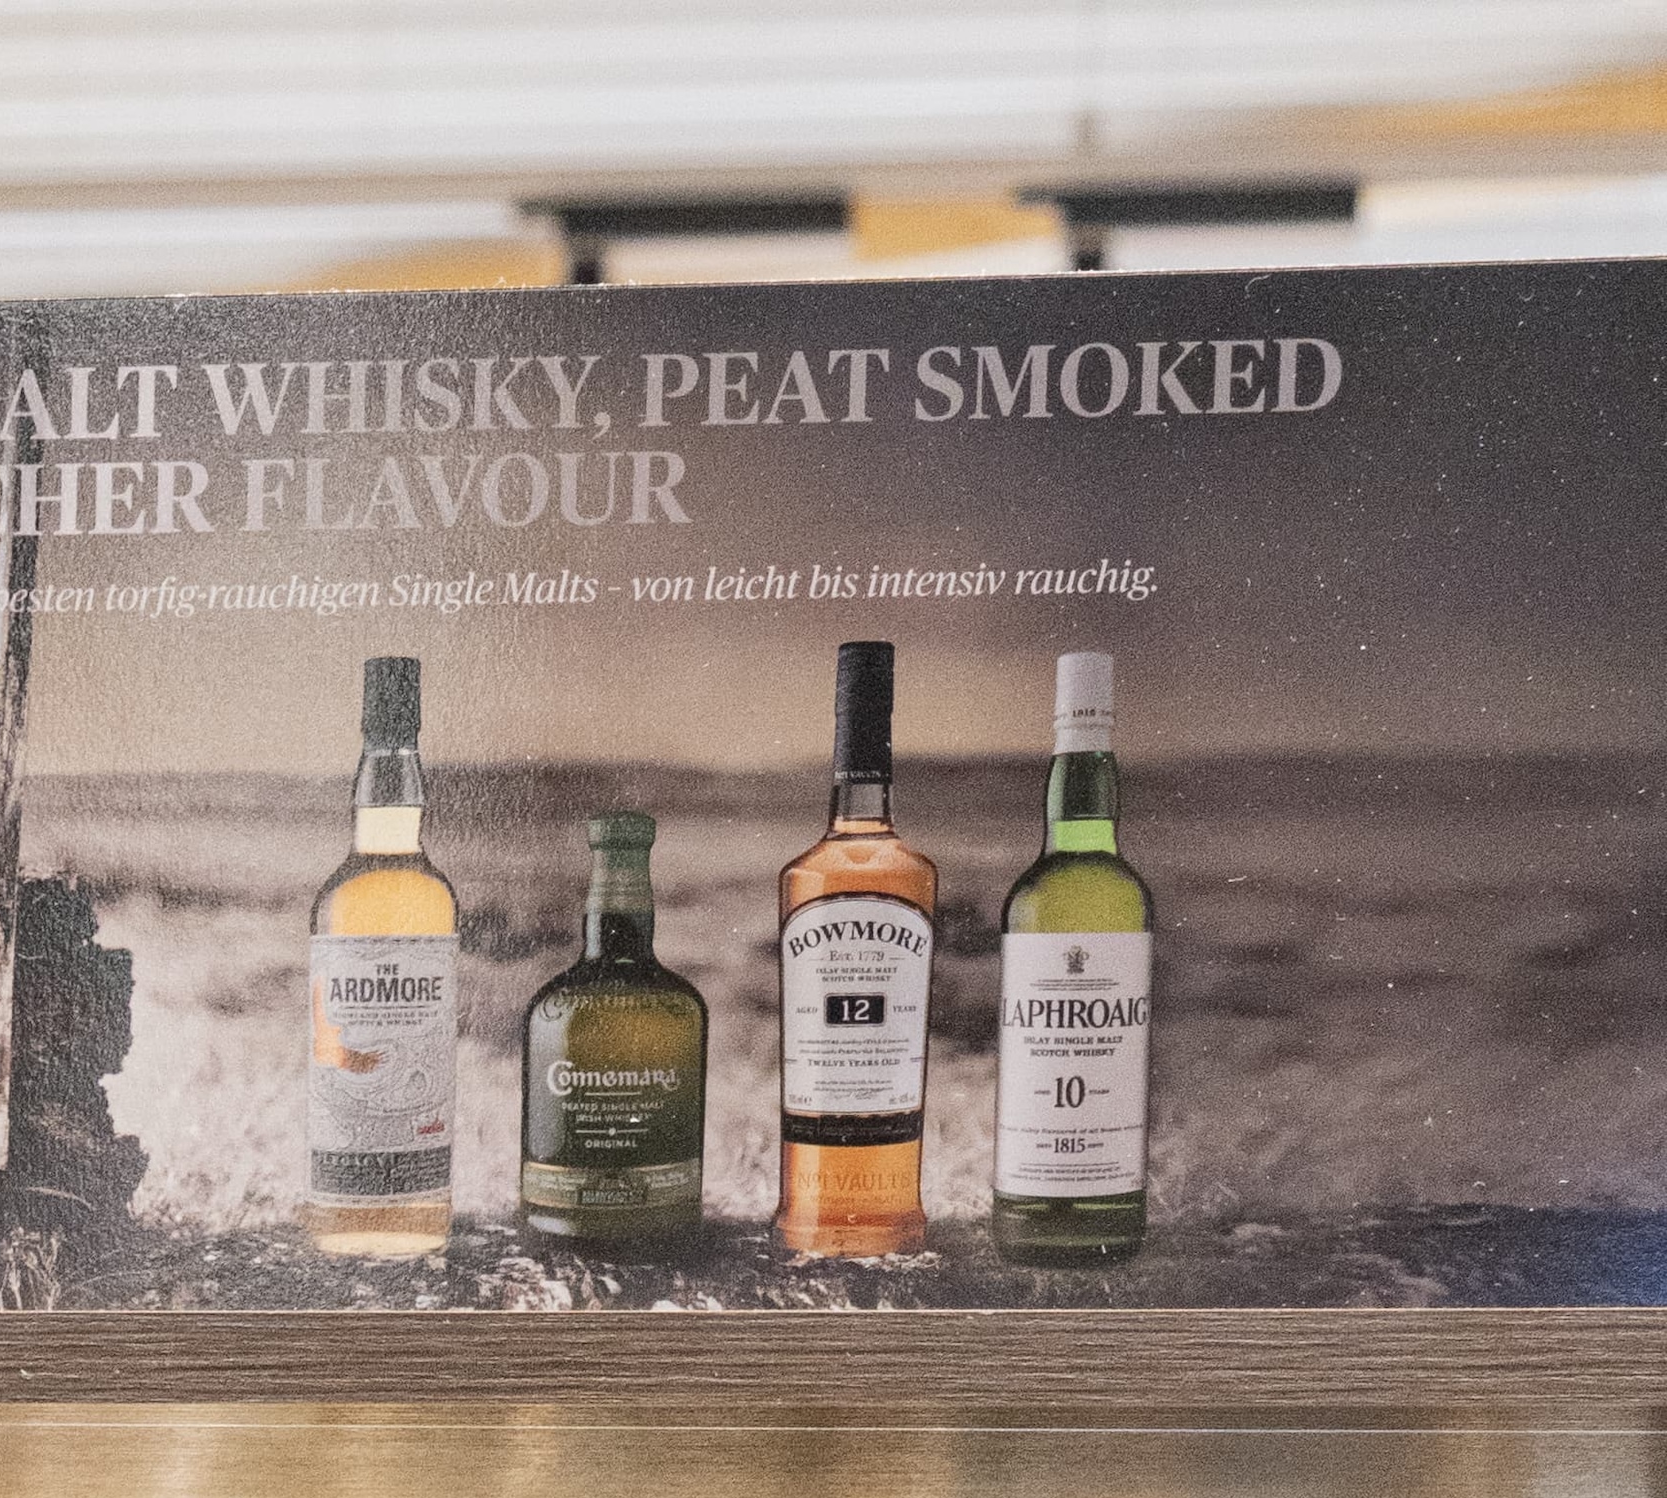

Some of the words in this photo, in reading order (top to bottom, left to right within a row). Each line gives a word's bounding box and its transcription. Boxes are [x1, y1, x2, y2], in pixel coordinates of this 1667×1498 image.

[202, 355, 610, 437] WHISKY,
[639, 348, 889, 427] PEAT
[914, 337, 1343, 422] SMOKED
[241, 452, 692, 531] FLAVOUR
[106, 575, 378, 619] torfig-rauchigen
[389, 573, 494, 615] Single
[502, 571, 598, 605] Malts
[633, 572, 690, 601] von
[704, 566, 801, 599] leicht
[809, 565, 859, 598] bis
[868, 563, 1006, 598] intensiv
[1014, 559, 1158, 601] rauchig.
[788, 920, 927, 959] BOWMORE
[330, 976, 443, 1003] ARDMORE
[547, 1061, 680, 1095] Connemara
